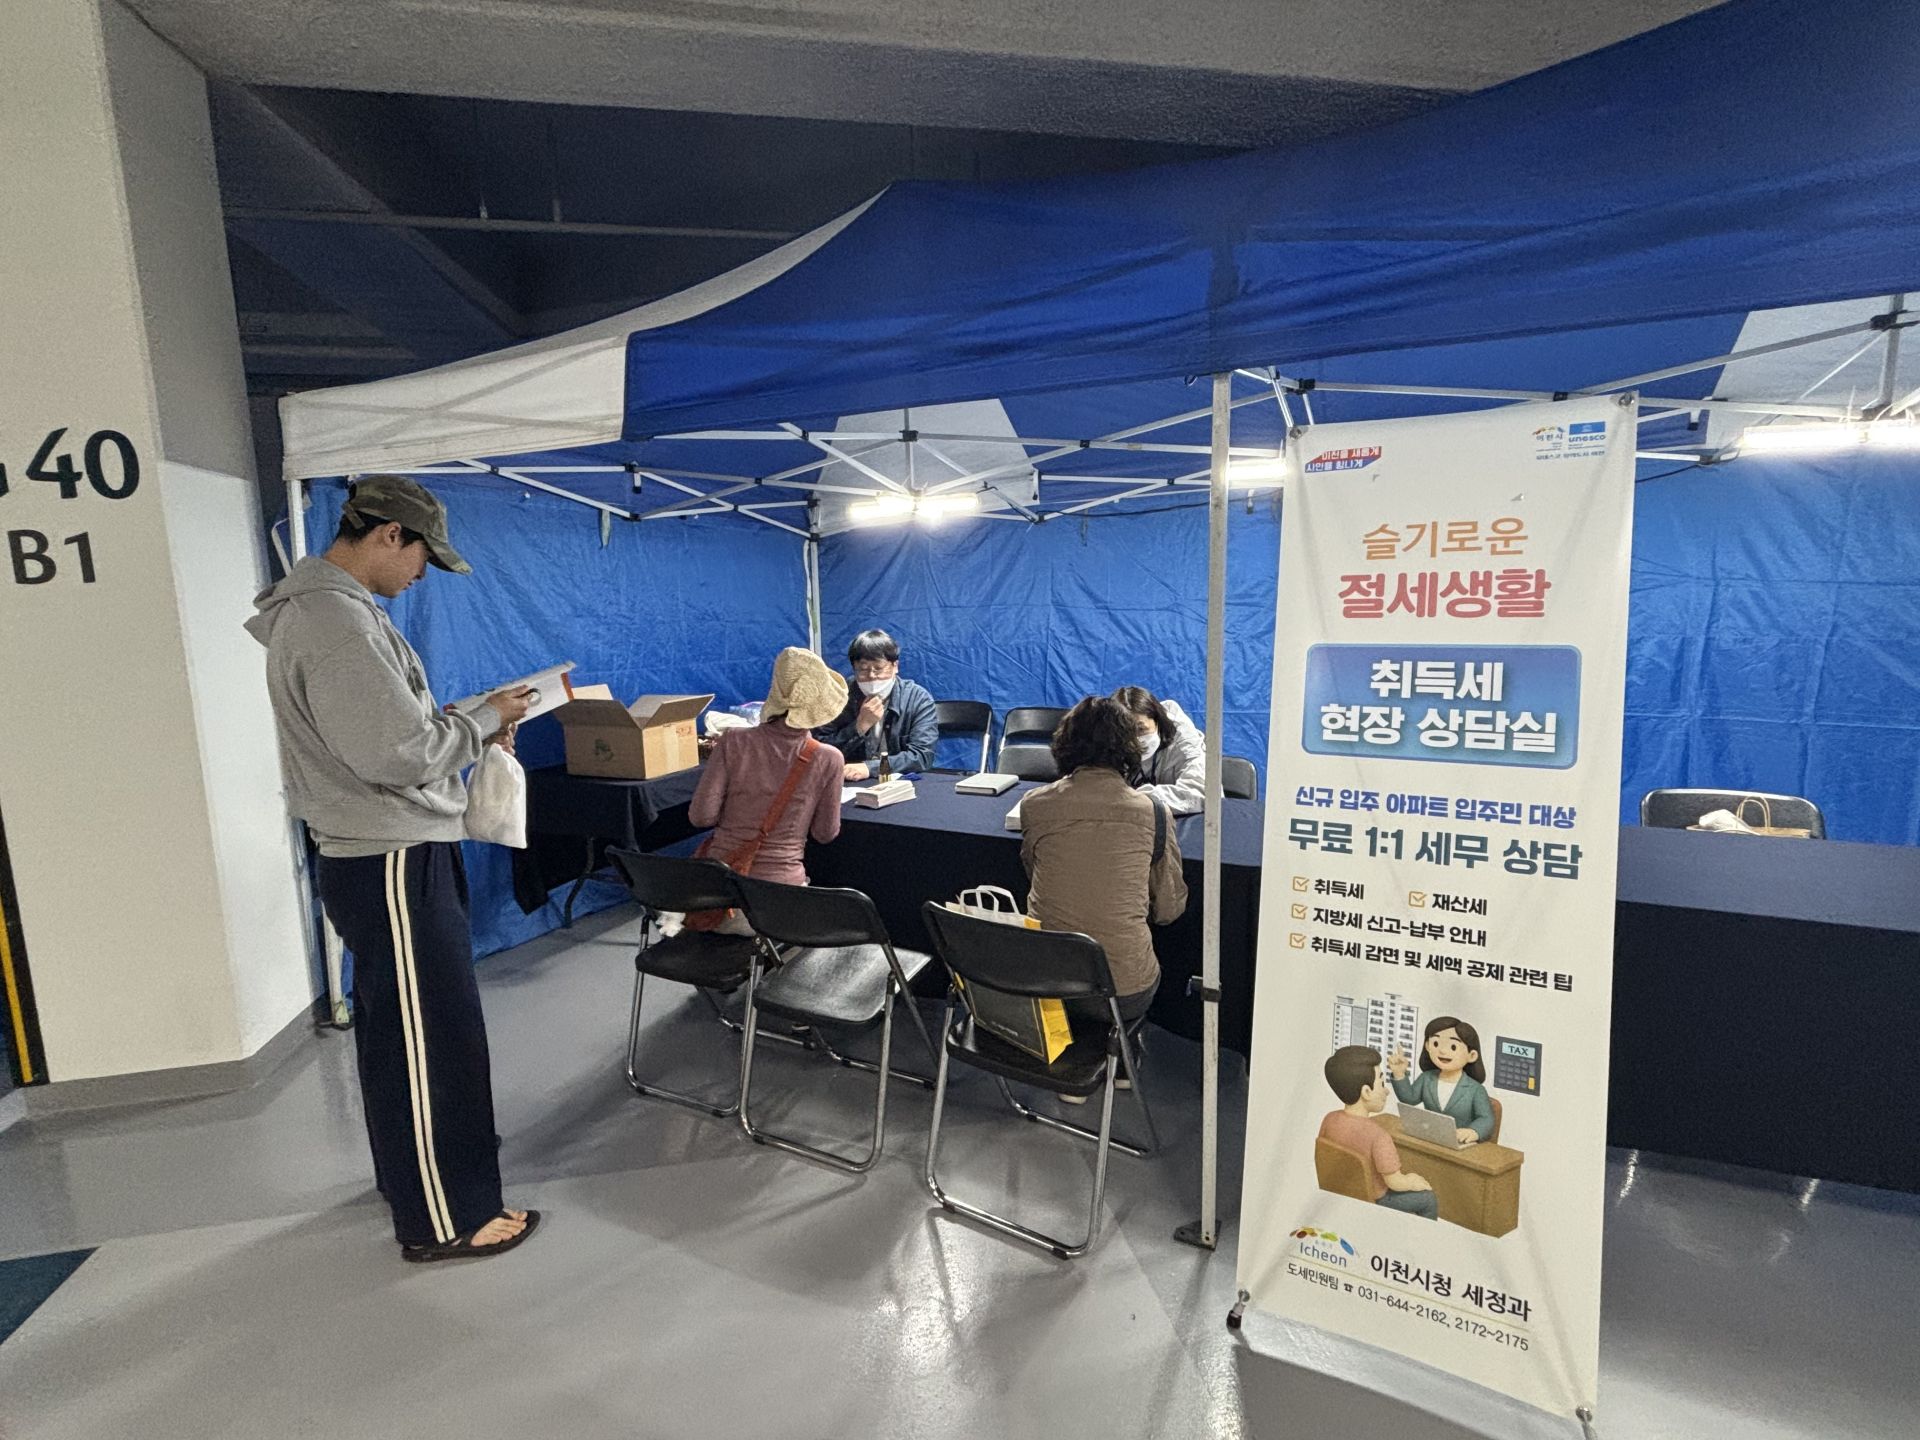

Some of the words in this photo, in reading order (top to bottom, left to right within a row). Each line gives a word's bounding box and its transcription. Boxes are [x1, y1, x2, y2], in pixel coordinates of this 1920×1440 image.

[1569, 434, 1606, 443] unesco
[26, 427, 140, 499] 40
[8, 529, 96, 585] B1
[1362, 516, 1528, 560] 슬기로운
[1338, 568, 1551, 619] 절세생활
[1370, 659, 1504, 701] 취득세
[1320, 703, 1405, 745] 현장
[1417, 708, 1557, 753] 상담실
[1295, 786, 1334, 808] 신규
[1339, 789, 1380, 812] 입주
[1386, 793, 1449, 817] 아파트
[1455, 798, 1522, 825] 입주민
[1529, 804, 1577, 829] 대상
[1288, 818, 1353, 854] 무료
[1365, 826, 1404, 860] 1:1
[1415, 831, 1489, 869] 세무
[1503, 839, 1583, 880] 상담
[1314, 879, 1364, 900] 취득세
[1432, 893, 1487, 916] 재산세
[1313, 907, 1362, 929] 지방세
[1449, 926, 1487, 947] 안내
[1311, 936, 1361, 959] 취득세
[1365, 945, 1399, 965] 감면
[1404, 950, 1421, 968] 및
[1426, 954, 1462, 975] 세액
[1467, 960, 1503, 982] 공제
[1509, 966, 1548, 988] 관련
[1554, 973, 1573, 993] 팁
[1508, 1045, 1528, 1056] TAX
[1300, 1241, 1347, 1268] Icheon
[1287, 1262, 1339, 1290] 도세민원팀
[1358, 1285, 1450, 1327] 031-644-2162,
[1455, 1317, 1529, 1351] 2172~2175
[1370, 1255, 1452, 1297] 이천시청
[1462, 1283, 1532, 1322] 세정과
